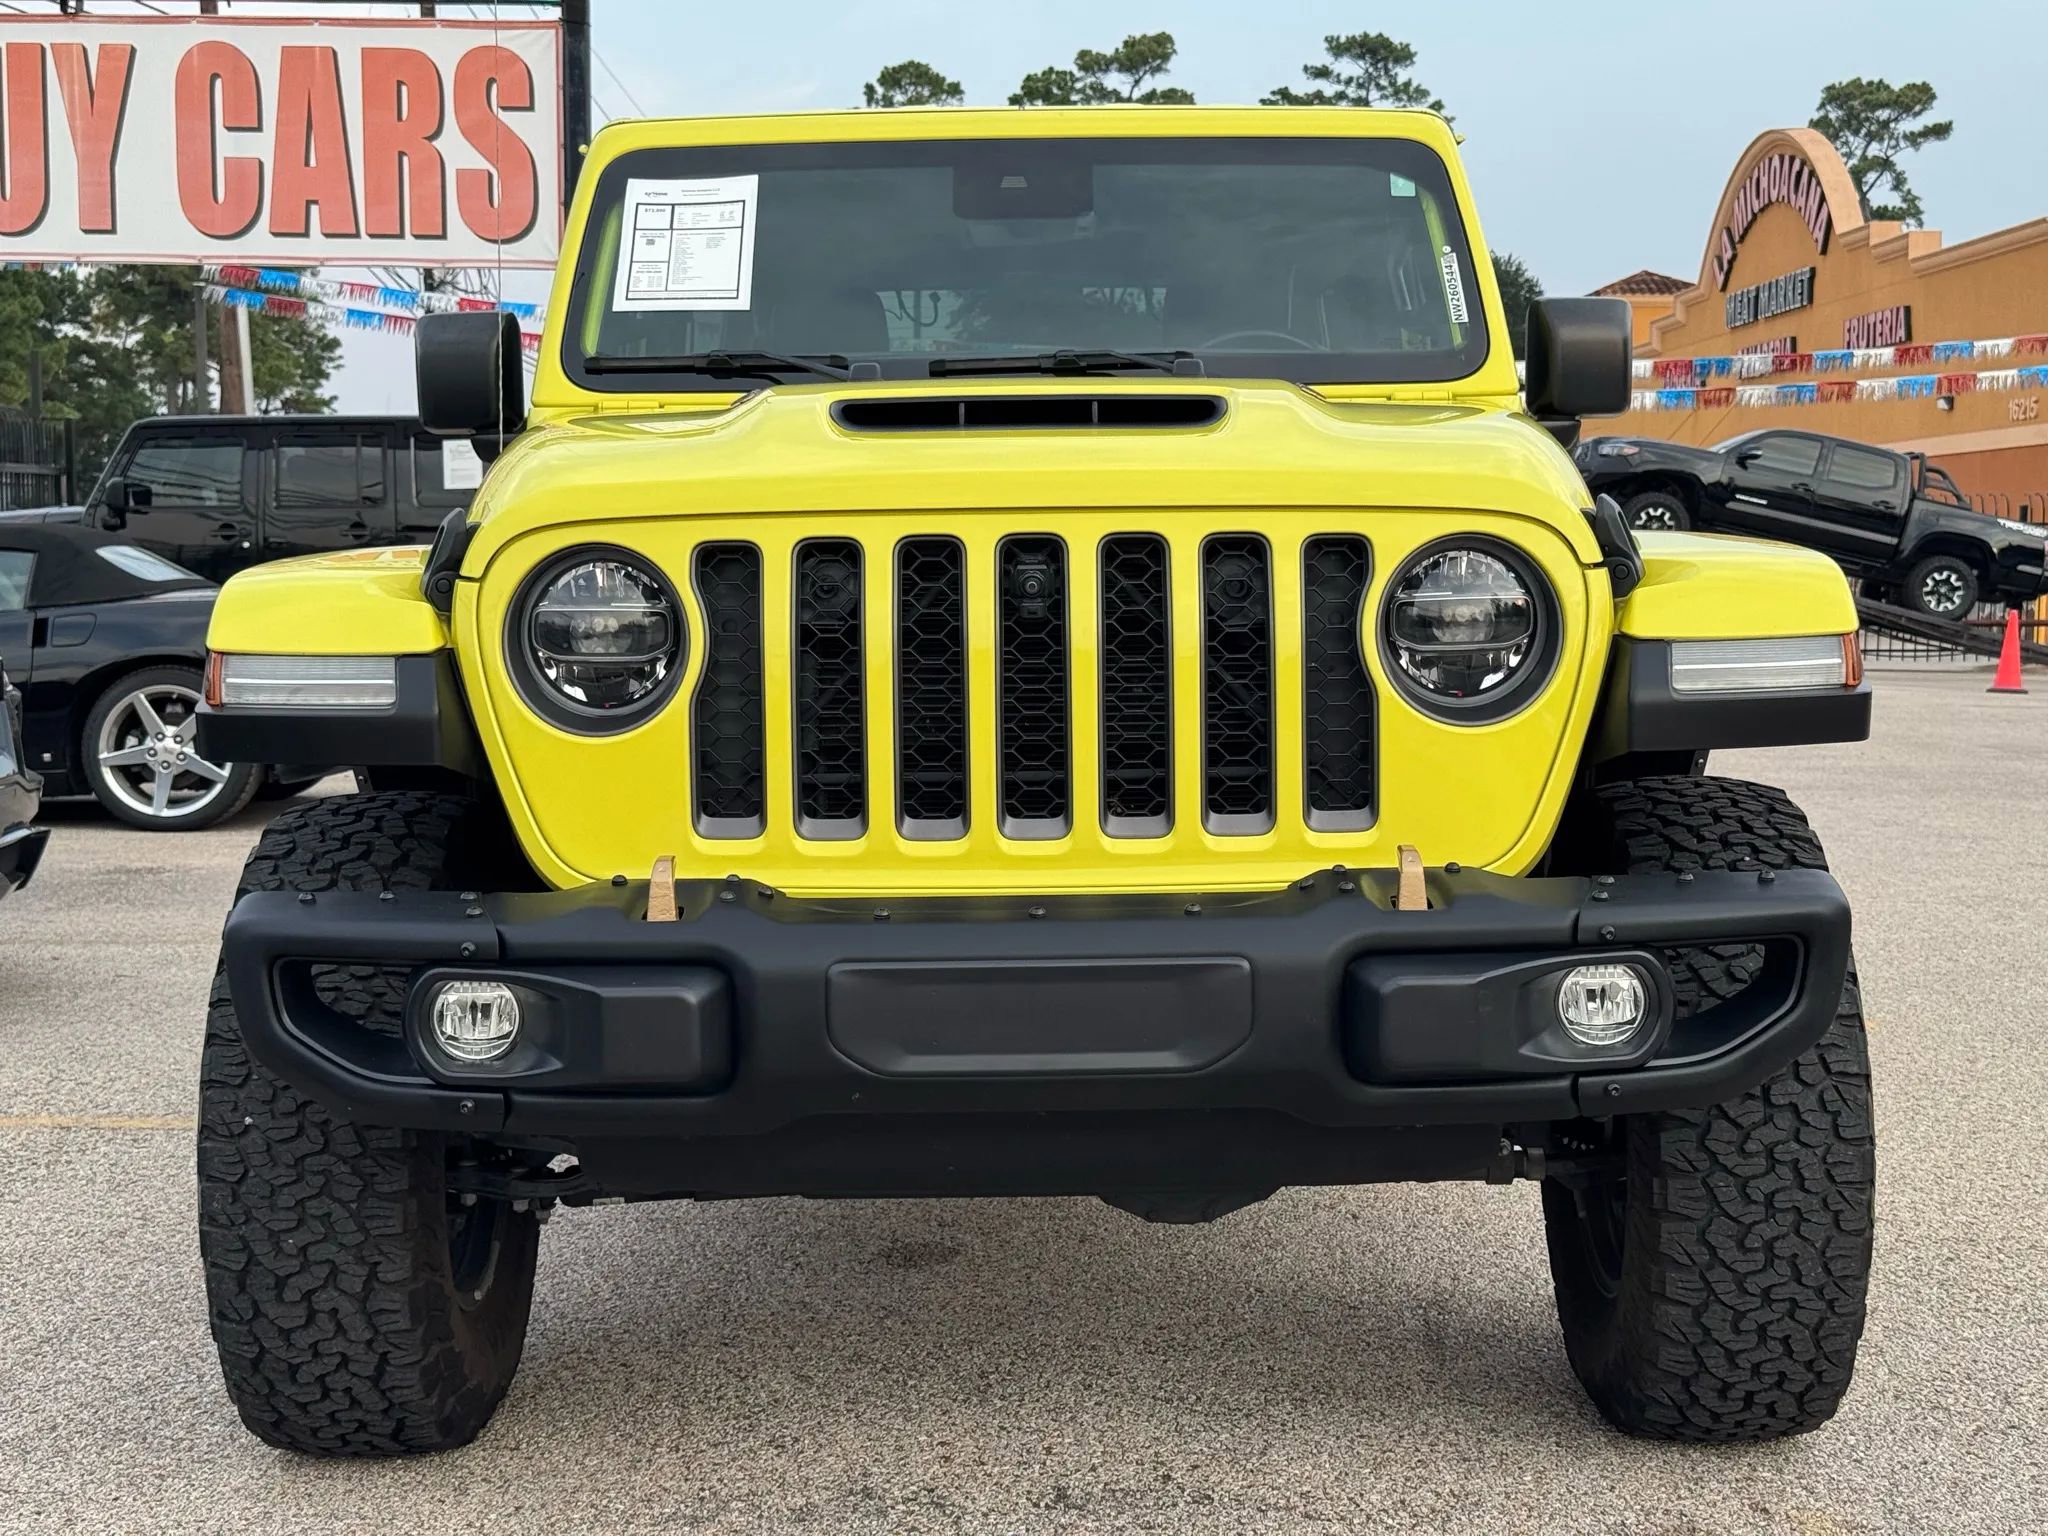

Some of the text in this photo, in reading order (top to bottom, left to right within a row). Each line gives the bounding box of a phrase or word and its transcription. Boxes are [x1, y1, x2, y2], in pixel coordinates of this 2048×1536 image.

[175, 40, 538, 245] CARS
[1712, 153, 1833, 292] LA MICHOACANA
[1444, 264, 1464, 322] NW260544
[1726, 266, 1815, 329] MEAT MARKET
[1843, 305, 1911, 350] FRUTERIA
[2008, 396, 2039, 422] 16215
